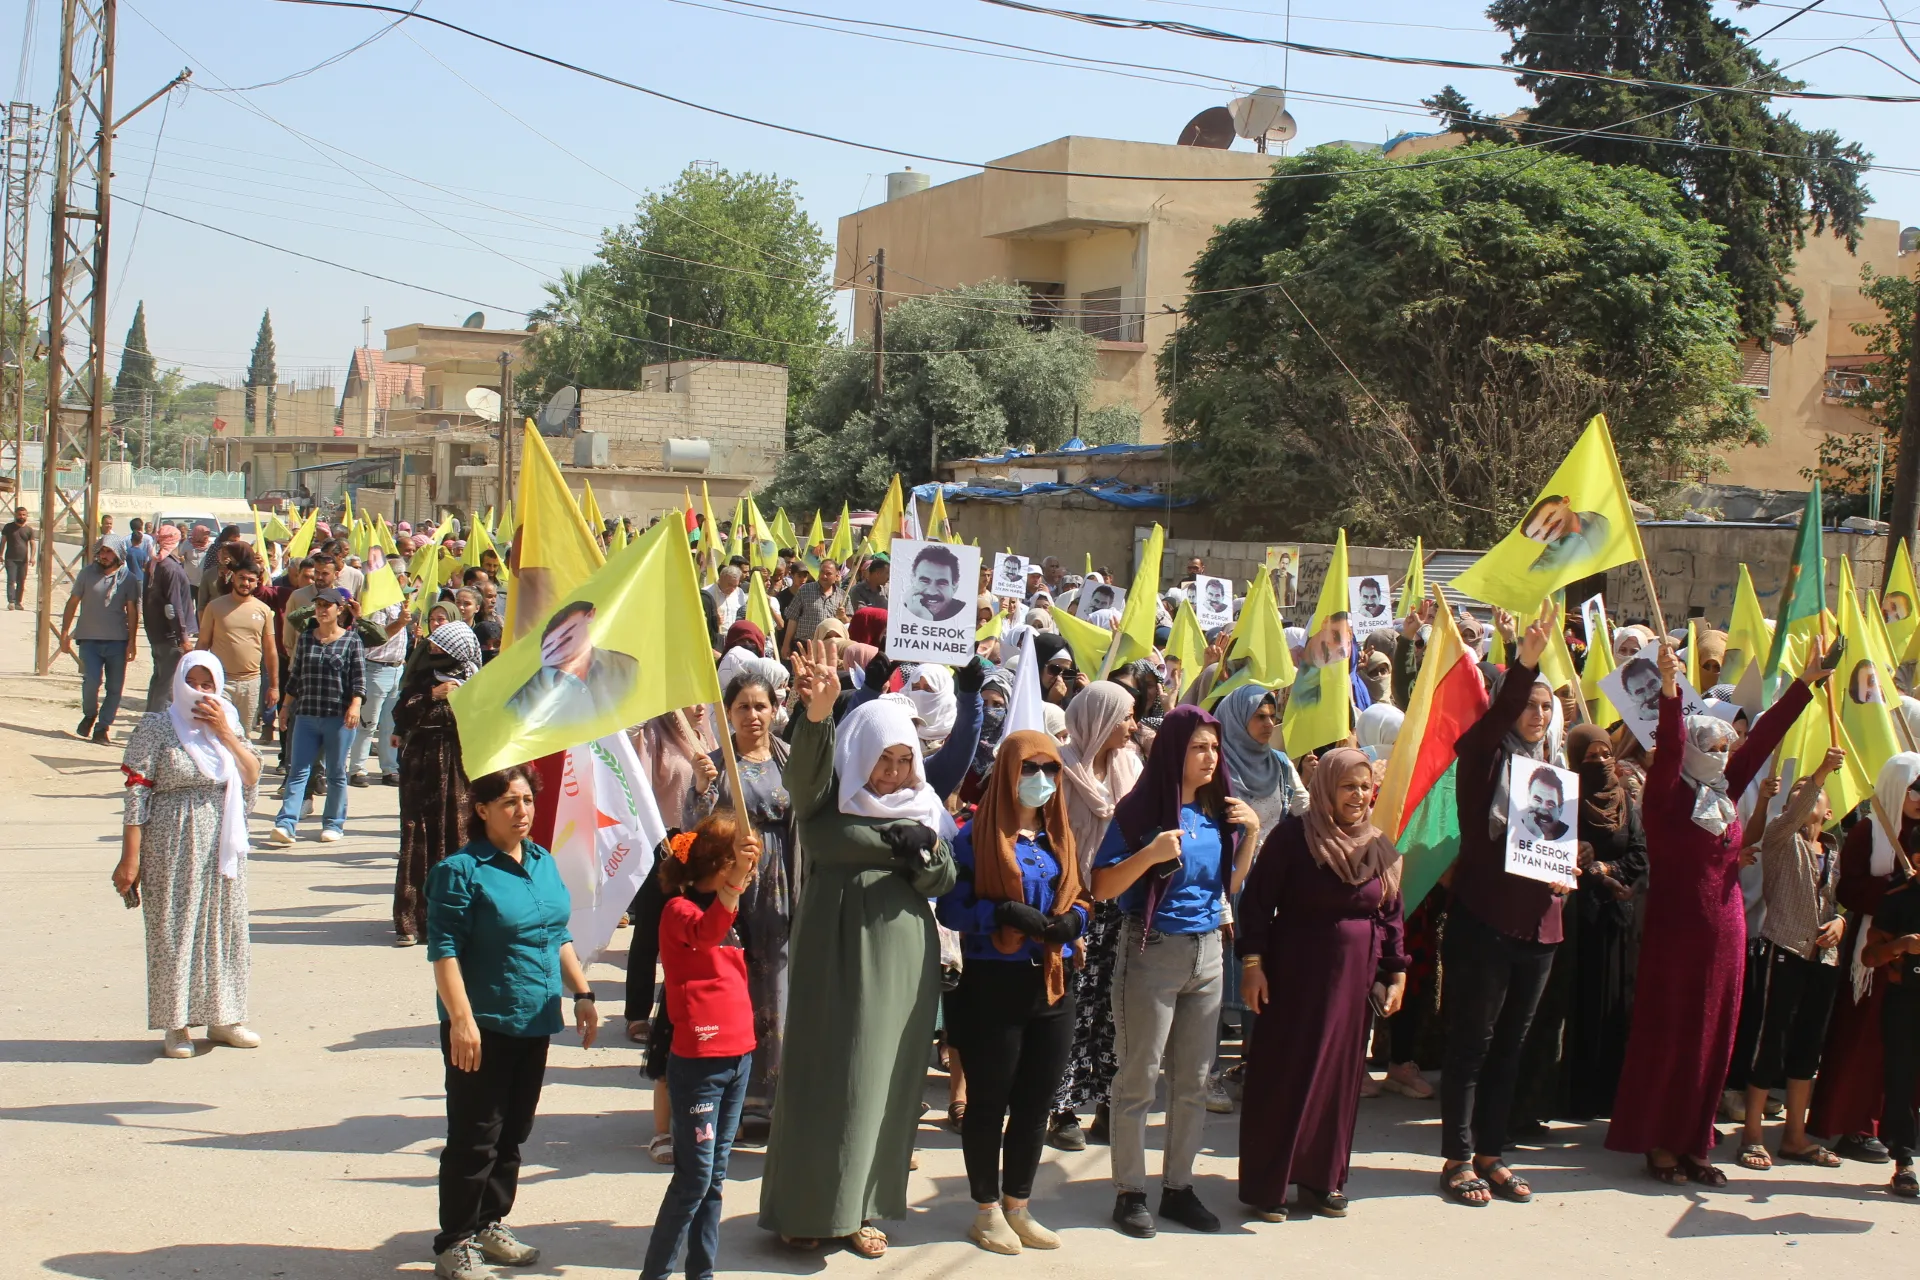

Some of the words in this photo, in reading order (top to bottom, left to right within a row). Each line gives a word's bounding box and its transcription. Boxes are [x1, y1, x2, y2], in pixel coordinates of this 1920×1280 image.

[900, 623, 919, 635] BÊ
[921, 626, 965, 640] SEROK
[1368, 619, 1388, 627] SEROK
[893, 637, 930, 650] JIYAN
[933, 641, 968, 654] NABE
[1518, 839, 1533, 852] BÊ
[1535, 844, 1570, 862] SEROK
[1512, 852, 1542, 868] JIYAN
[1544, 861, 1573, 875] NABE
[694, 1025, 719, 1033] Reebok
